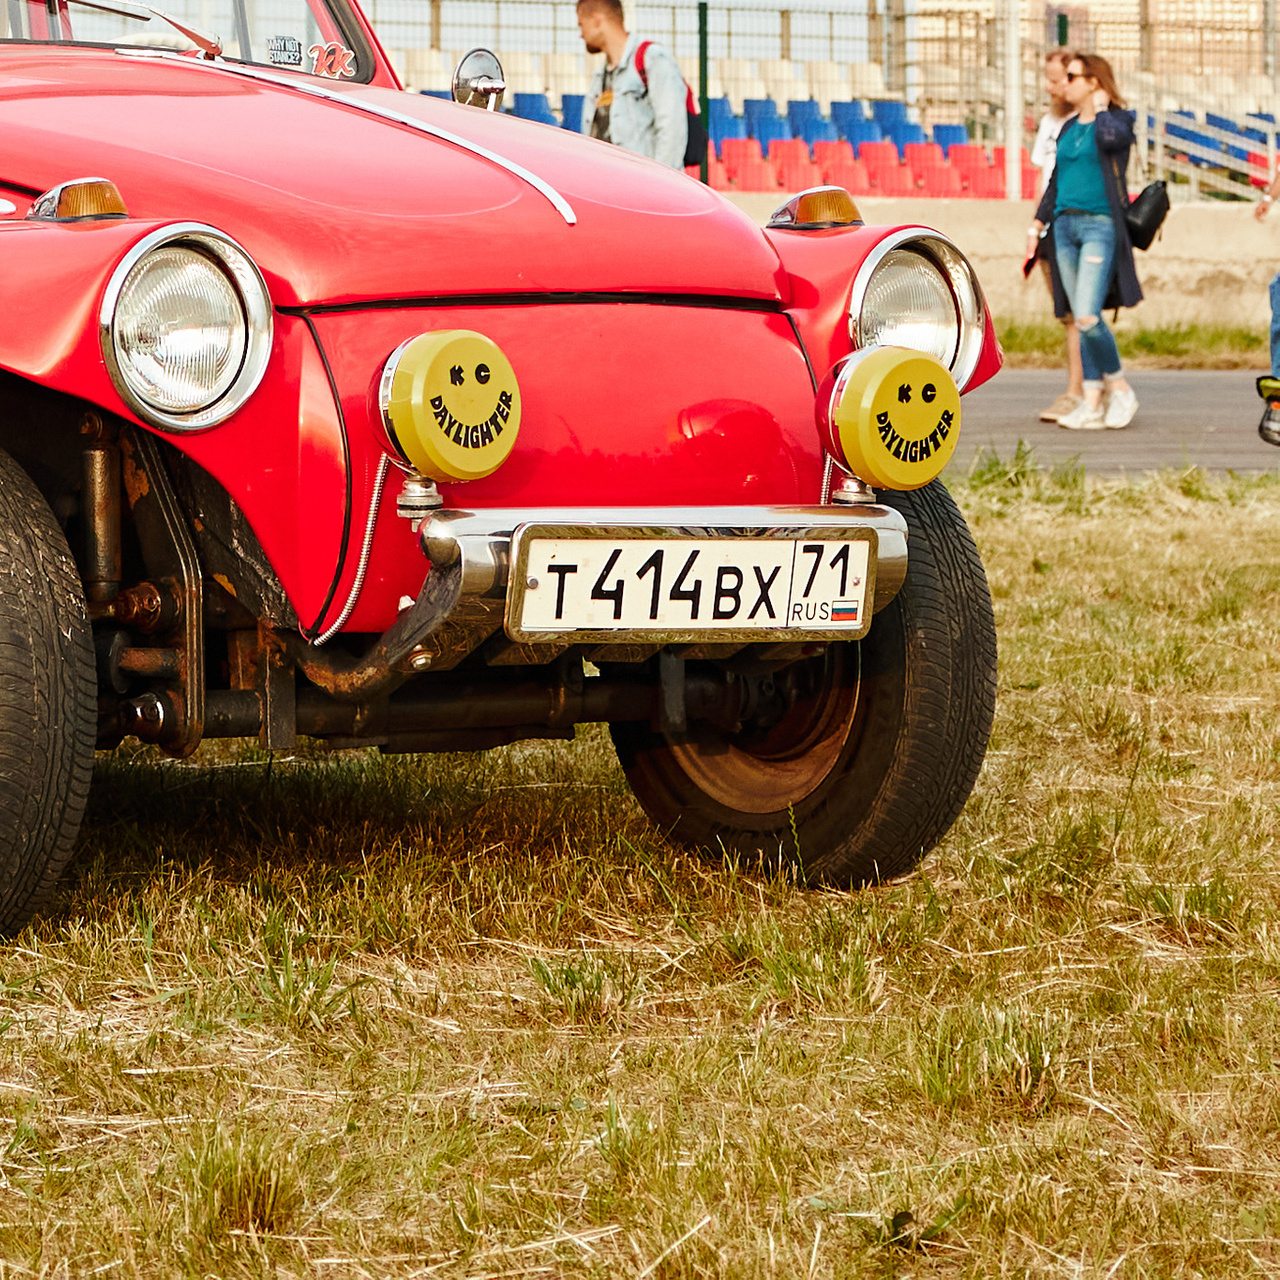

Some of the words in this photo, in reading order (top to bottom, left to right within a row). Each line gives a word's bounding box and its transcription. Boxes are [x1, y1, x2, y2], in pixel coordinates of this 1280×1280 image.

[267, 38, 284, 51] WHY
[285, 40, 300, 52] NOT
[430, 391, 512, 449] DAYLIGHTER
[876, 410, 954, 463] DAYLIGHTER
[803, 544, 850, 598] 71
[792, 602, 829, 621] RUS
